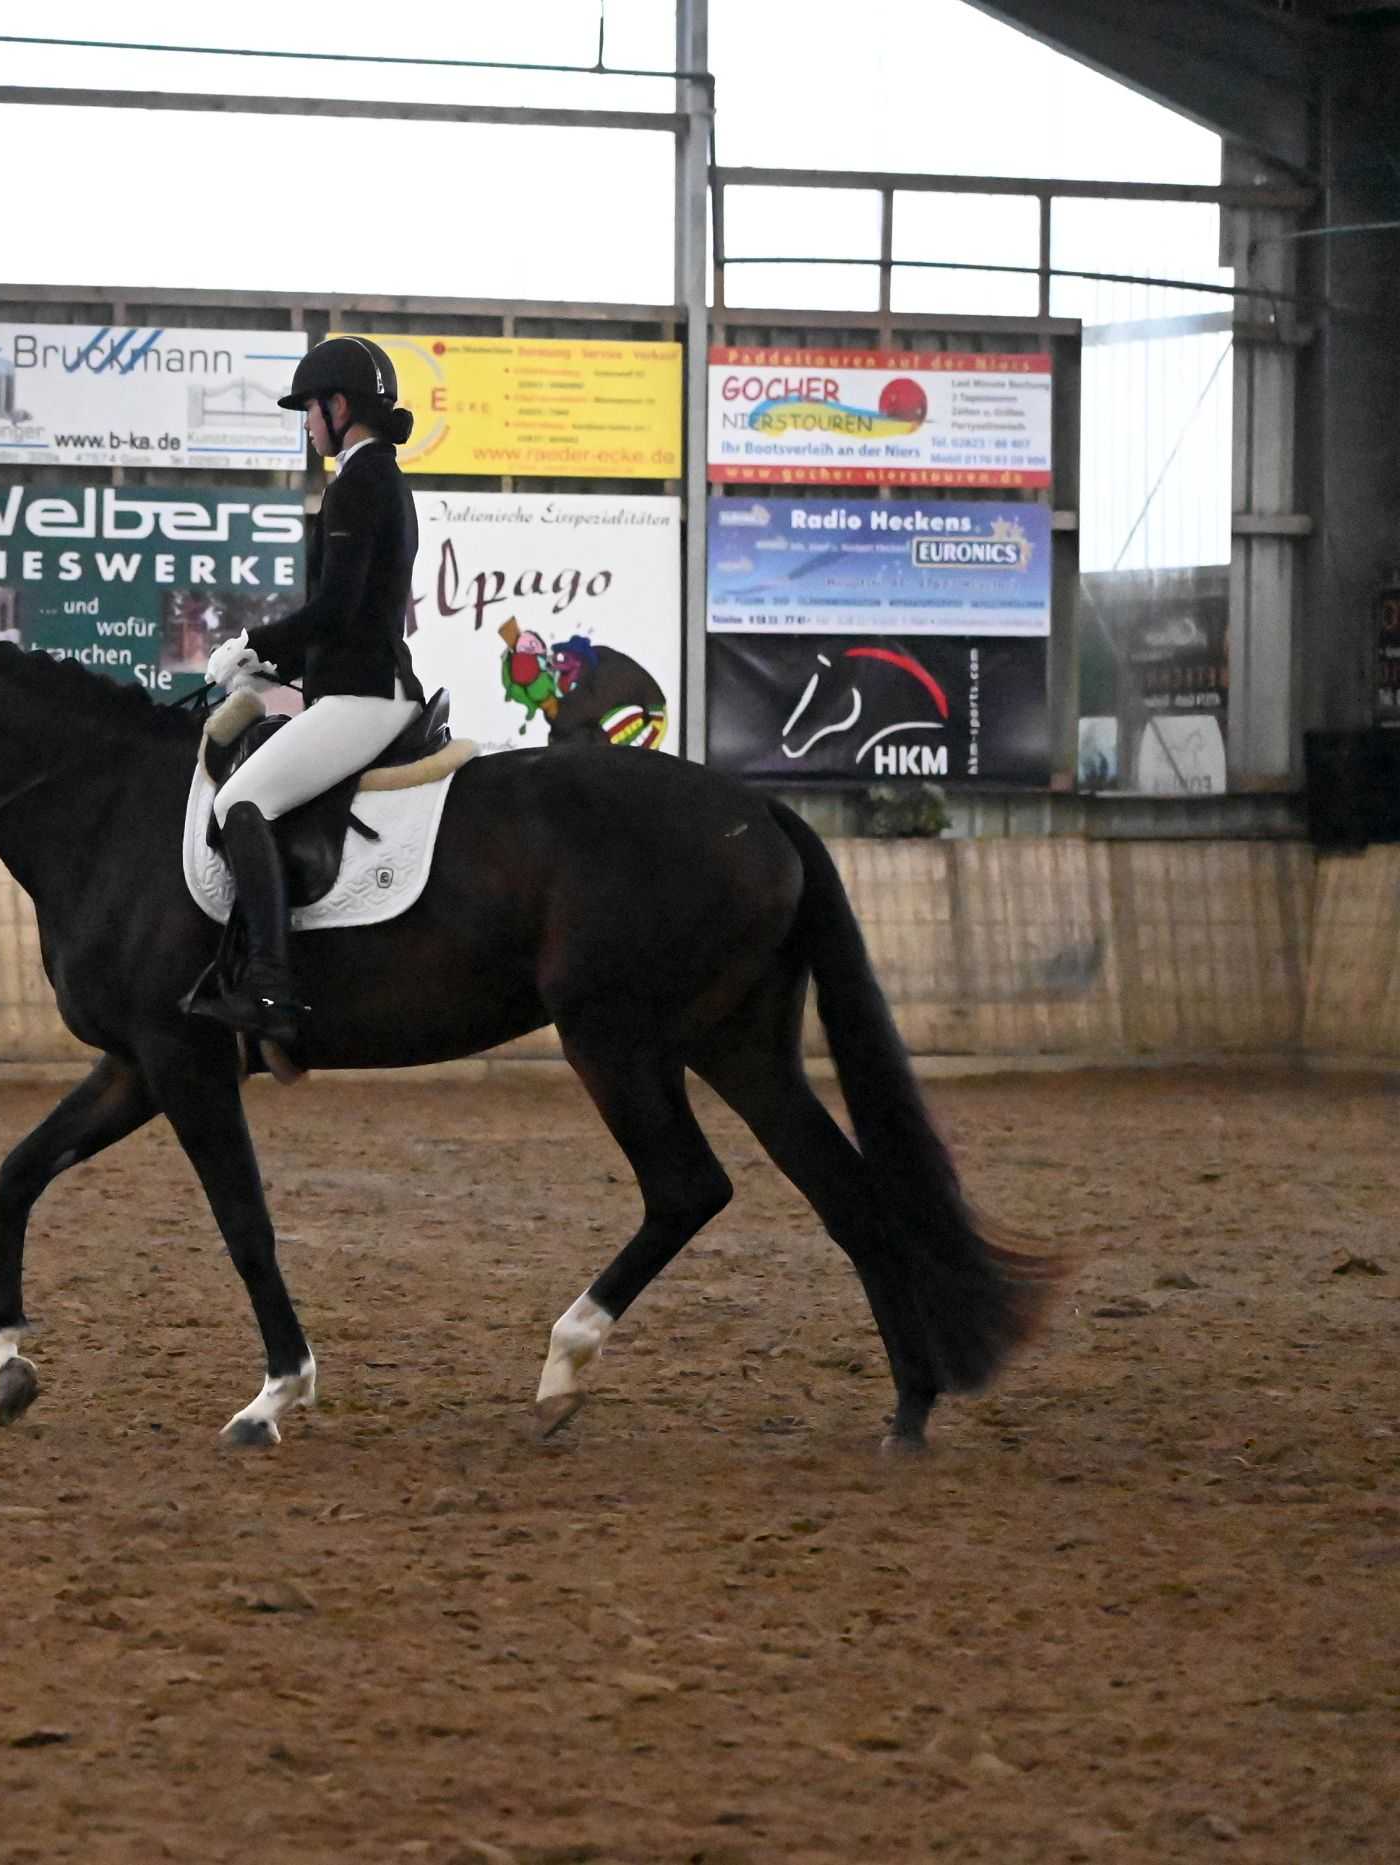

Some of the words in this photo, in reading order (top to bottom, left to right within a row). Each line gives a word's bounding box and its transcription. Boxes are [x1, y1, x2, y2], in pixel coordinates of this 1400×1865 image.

[14, 335, 232, 374] Bruckmann
[722, 376, 840, 401] GOCHER
[722, 413, 873, 432] NIERSTOUREN
[791, 509, 862, 531] Radio
[870, 510, 972, 533] Heckens
[919, 541, 1016, 564] EURONICS
[64, 597, 99, 615] und
[96, 615, 156, 637] wofür
[133, 663, 172, 690] Sie
[875, 745, 948, 775] HKM
